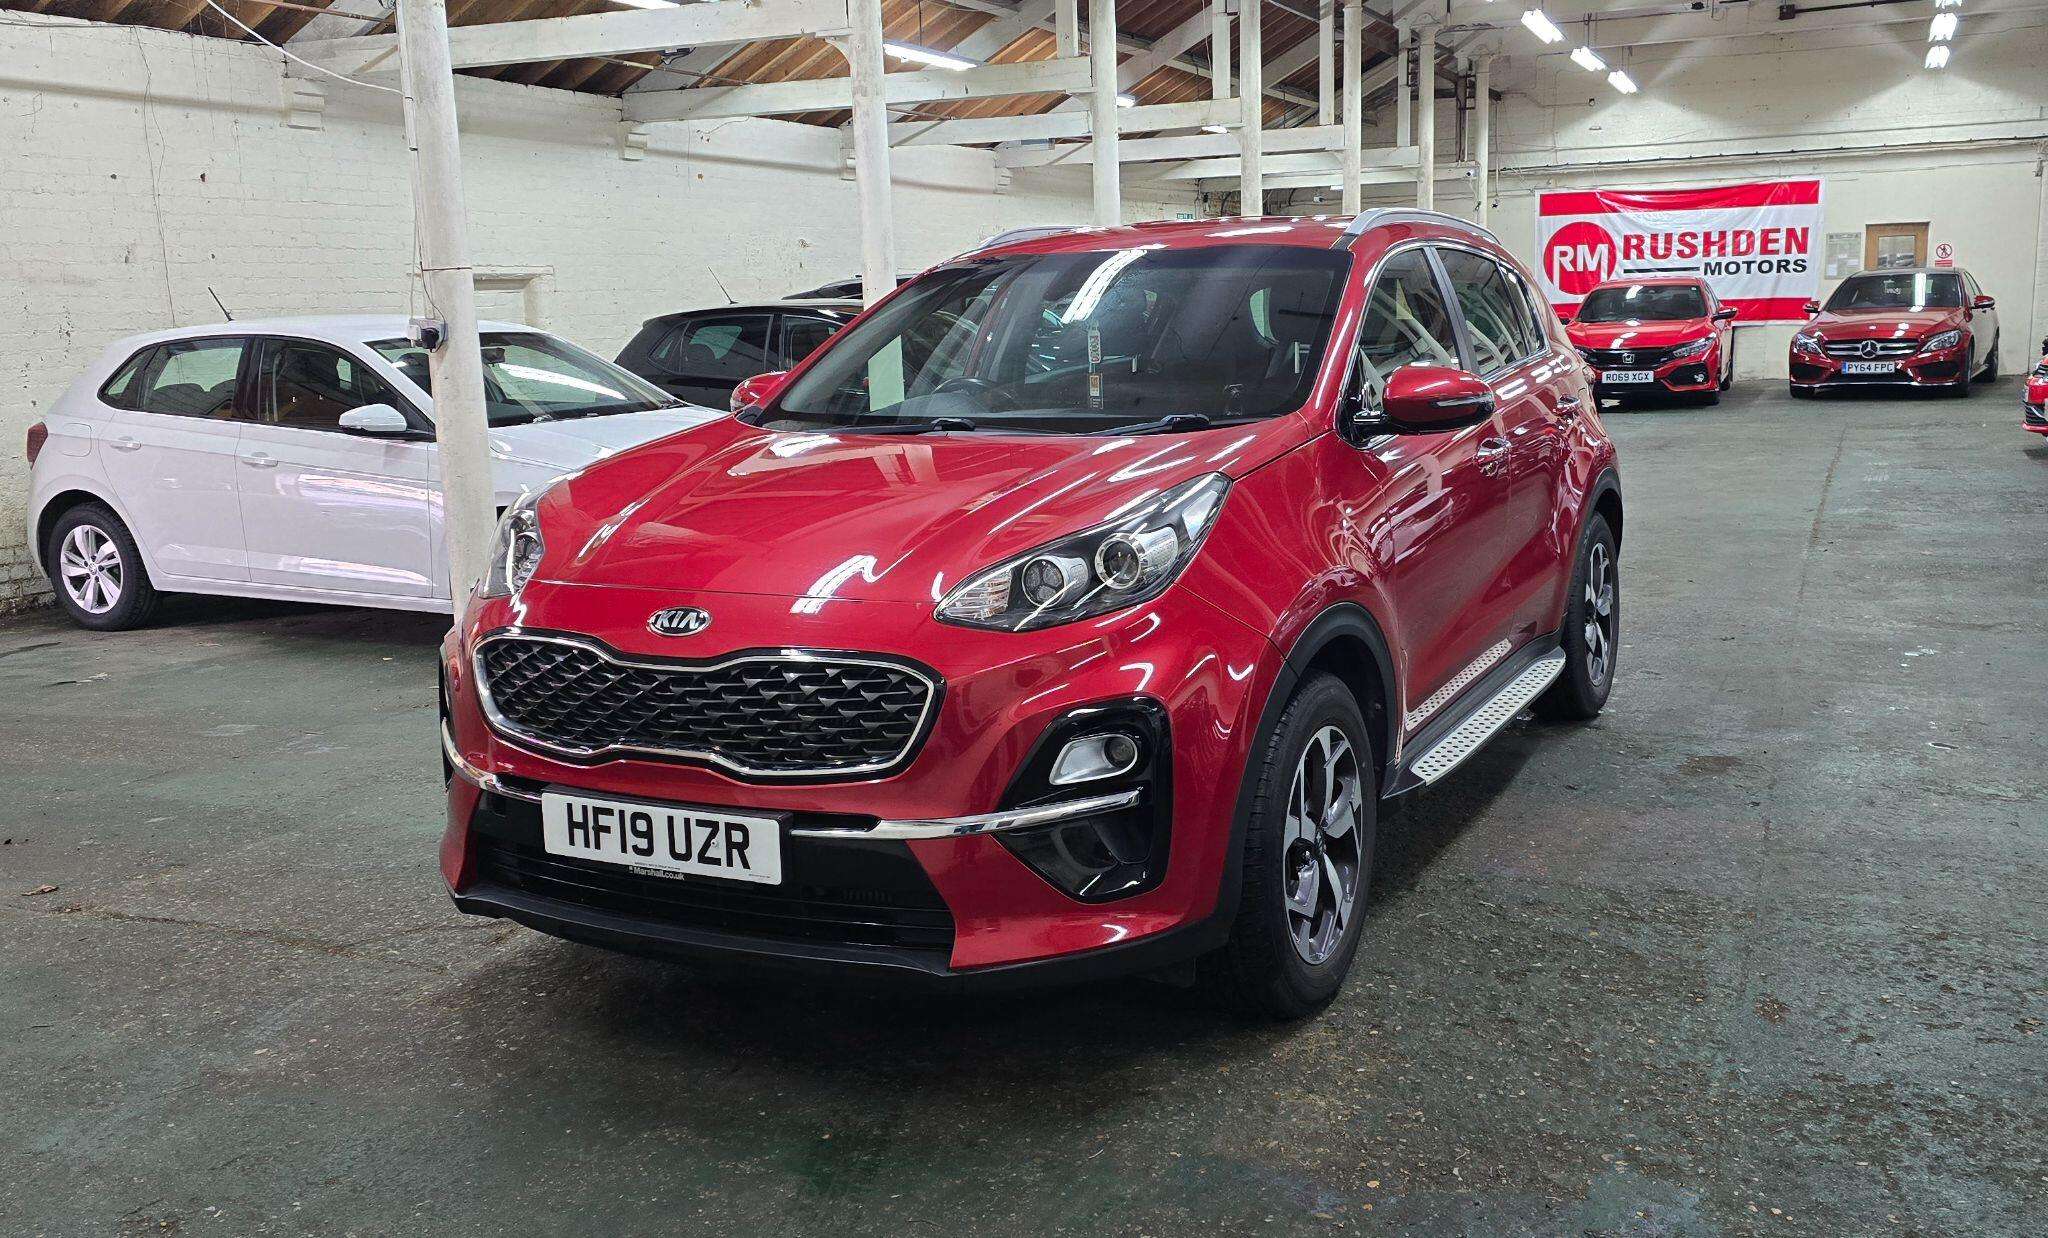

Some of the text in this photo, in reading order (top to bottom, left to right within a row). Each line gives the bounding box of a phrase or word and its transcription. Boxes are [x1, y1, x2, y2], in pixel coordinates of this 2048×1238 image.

[1622, 227, 1810, 261] RUSHDEN
[1553, 243, 1609, 286] RM
[1703, 258, 1808, 277] MOTORS
[1606, 372, 1650, 382] RO69 XGX
[1847, 363, 1893, 372] PY64 FPC
[655, 610, 699, 630] KIA
[566, 802, 751, 870] HF19 UZR
[633, 866, 685, 881] Marshall.co.uk
